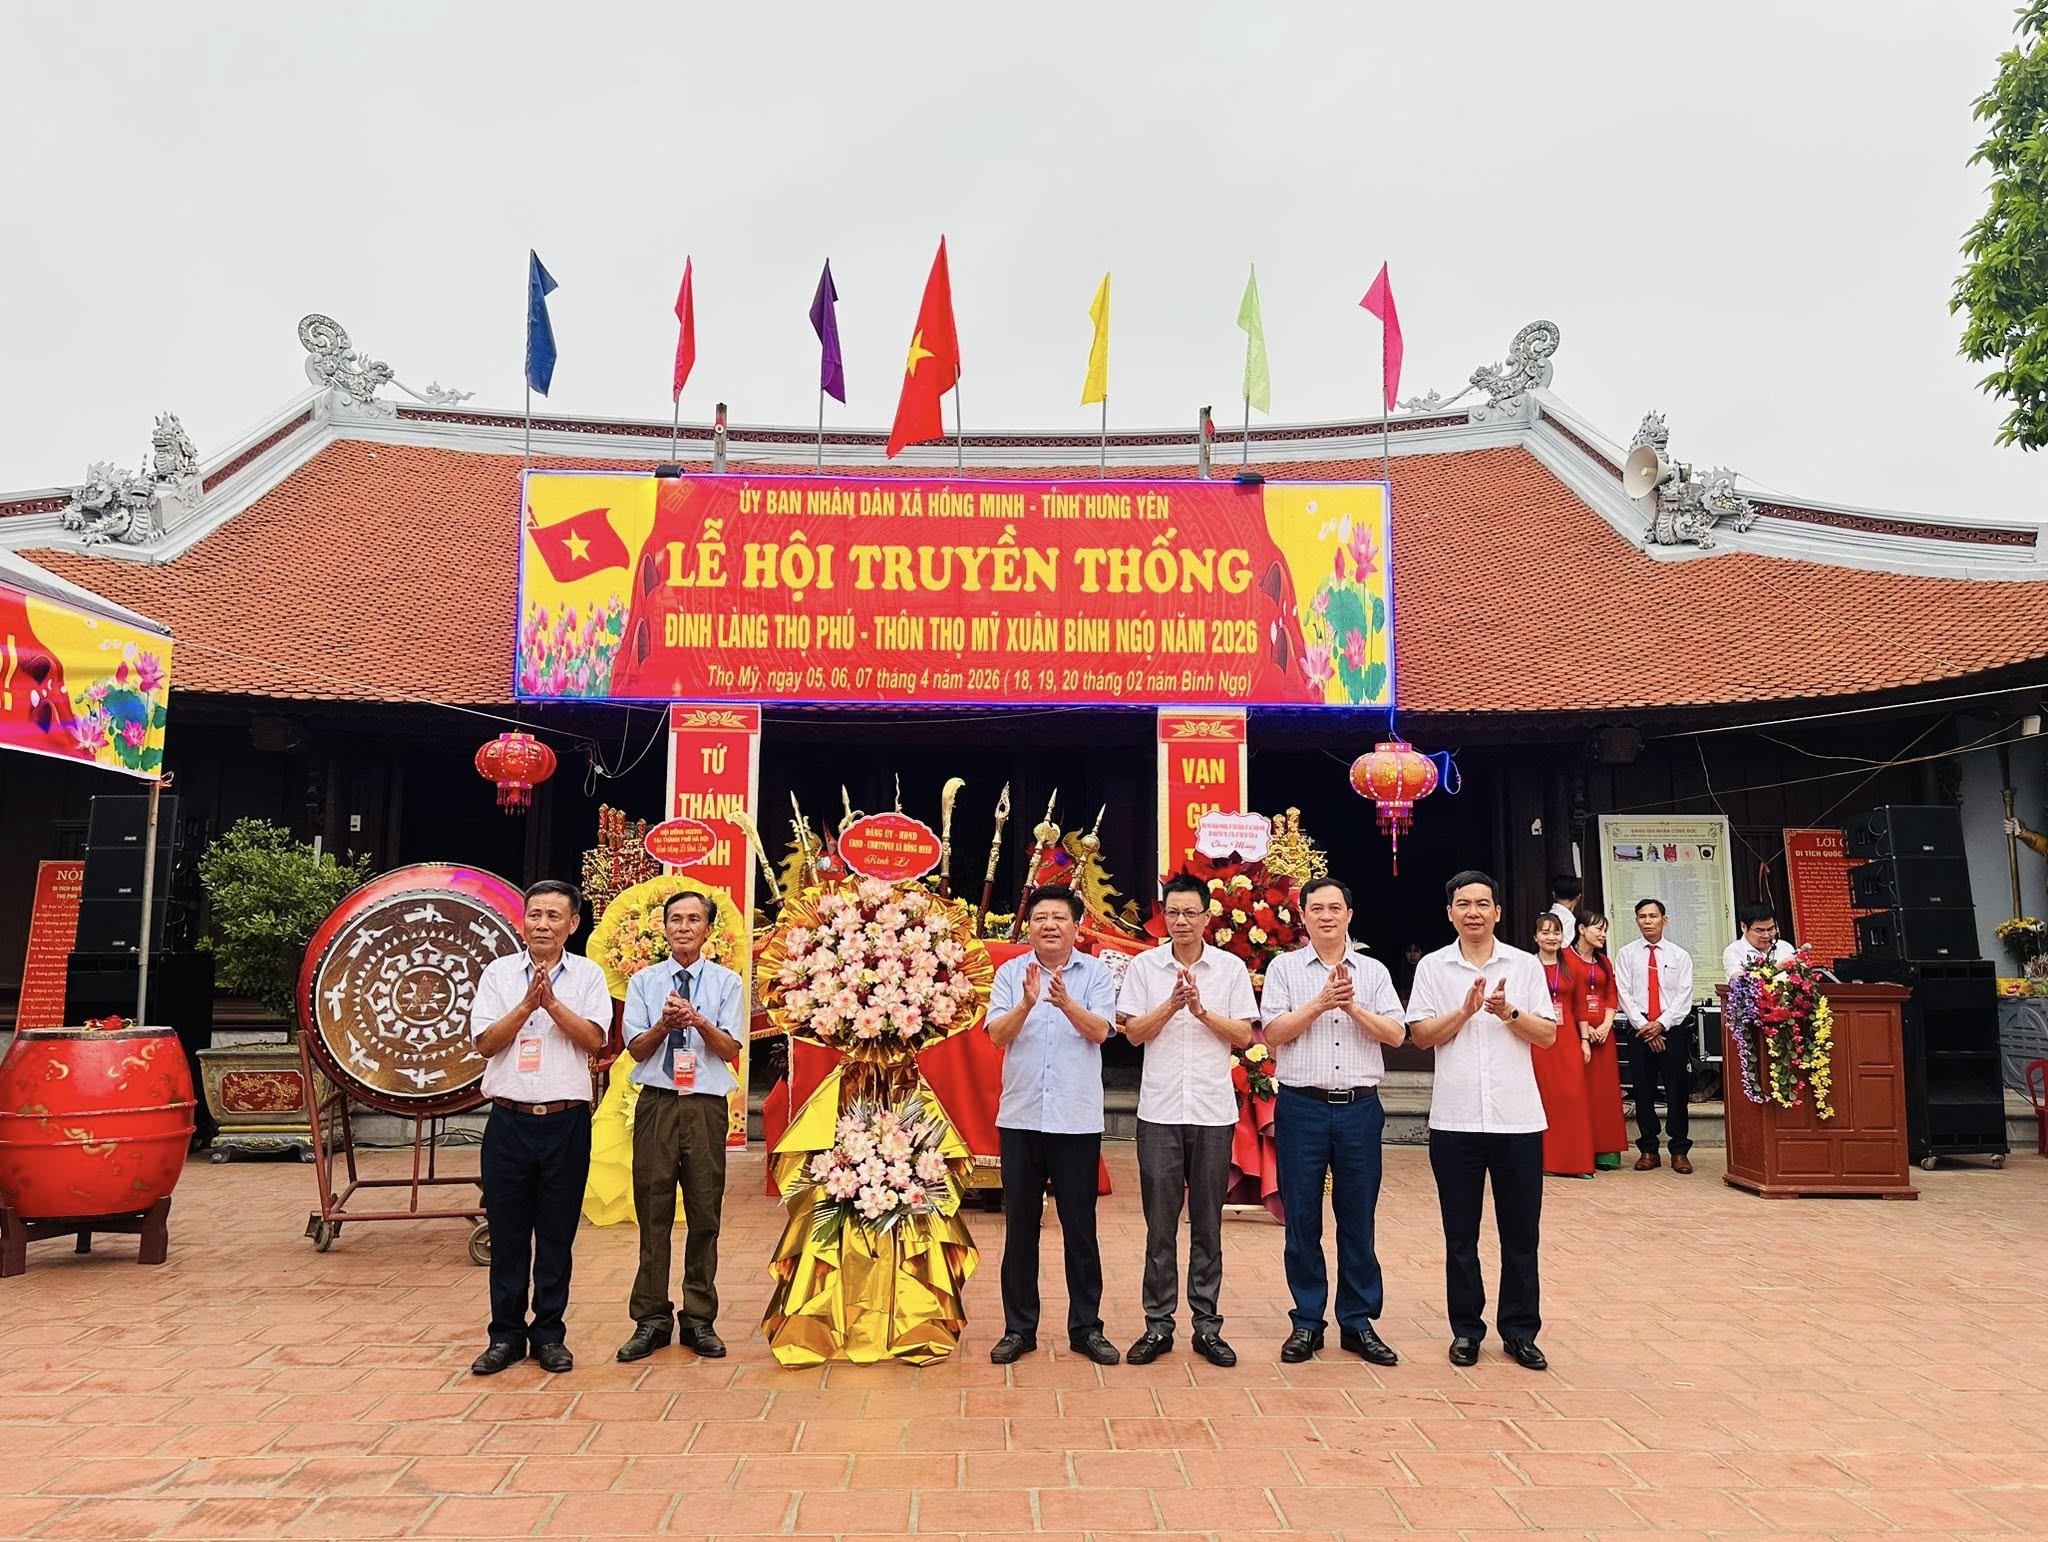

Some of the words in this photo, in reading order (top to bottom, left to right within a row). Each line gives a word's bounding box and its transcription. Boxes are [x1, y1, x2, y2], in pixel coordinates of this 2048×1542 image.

[739, 481, 762, 514] ỦY
[766, 490, 802, 515] BAN
[807, 486, 855, 516] NHÂN
[860, 487, 895, 516] DÂN
[900, 487, 923, 517] XÃ
[928, 485, 975, 517] HỒNG
[980, 494, 1025, 518] MINH
[1041, 486, 1080, 519] TỈNH
[1085, 492, 1131, 519] HƯNG
[1136, 490, 1169, 519] YÊN
[665, 517, 728, 588] LỄ
[742, 530, 835, 602] HỘI
[849, 524, 1060, 592] TRUYỀN
[1074, 527, 1254, 593] THỐNG
[664, 606, 713, 648] ĐÌNH
[717, 606, 769, 649] LÀNG
[774, 614, 811, 657] THỌ
[816, 608, 855, 650] PHÚ
[873, 609, 924, 651] THÔN
[929, 616, 966, 659] THỌ
[971, 611, 1000, 652] MỸ
[1006, 611, 1058, 652] XUÂN
[1064, 611, 1110, 653] BÍNH
[1116, 617, 1155, 661] NGỌ
[1161, 611, 1206, 654] NĂM
[1211, 619, 1259, 654] 2026
[708, 665, 735, 692] Thọ
[738, 665, 763, 692] Mỹ,
[767, 666, 802, 693] ngày
[806, 667, 827, 691] 05,
[831, 667, 851, 691] 06,
[855, 667, 873, 689] 07
[876, 667, 917, 694] tháng
[920, 668, 930, 690] 4
[933, 669, 963, 690] năm
[968, 668, 1000, 690] 2026
[1038, 669, 1057, 694] 19,
[1062, 670, 1079, 691] 20
[1083, 669, 1123, 696] tháng
[1126, 670, 1144, 692] 02
[1147, 670, 1177, 692] năm
[1181, 670, 1214, 692] Bính
[1218, 671, 1252, 697] Ngọ)
[701, 742, 728, 775] TỨ
[1181, 757, 1225, 790] VẠN
[679, 787, 745, 820] THÁNH
[1816, 835, 1836, 847] LỜI
[56, 867, 84, 883] NỘI
